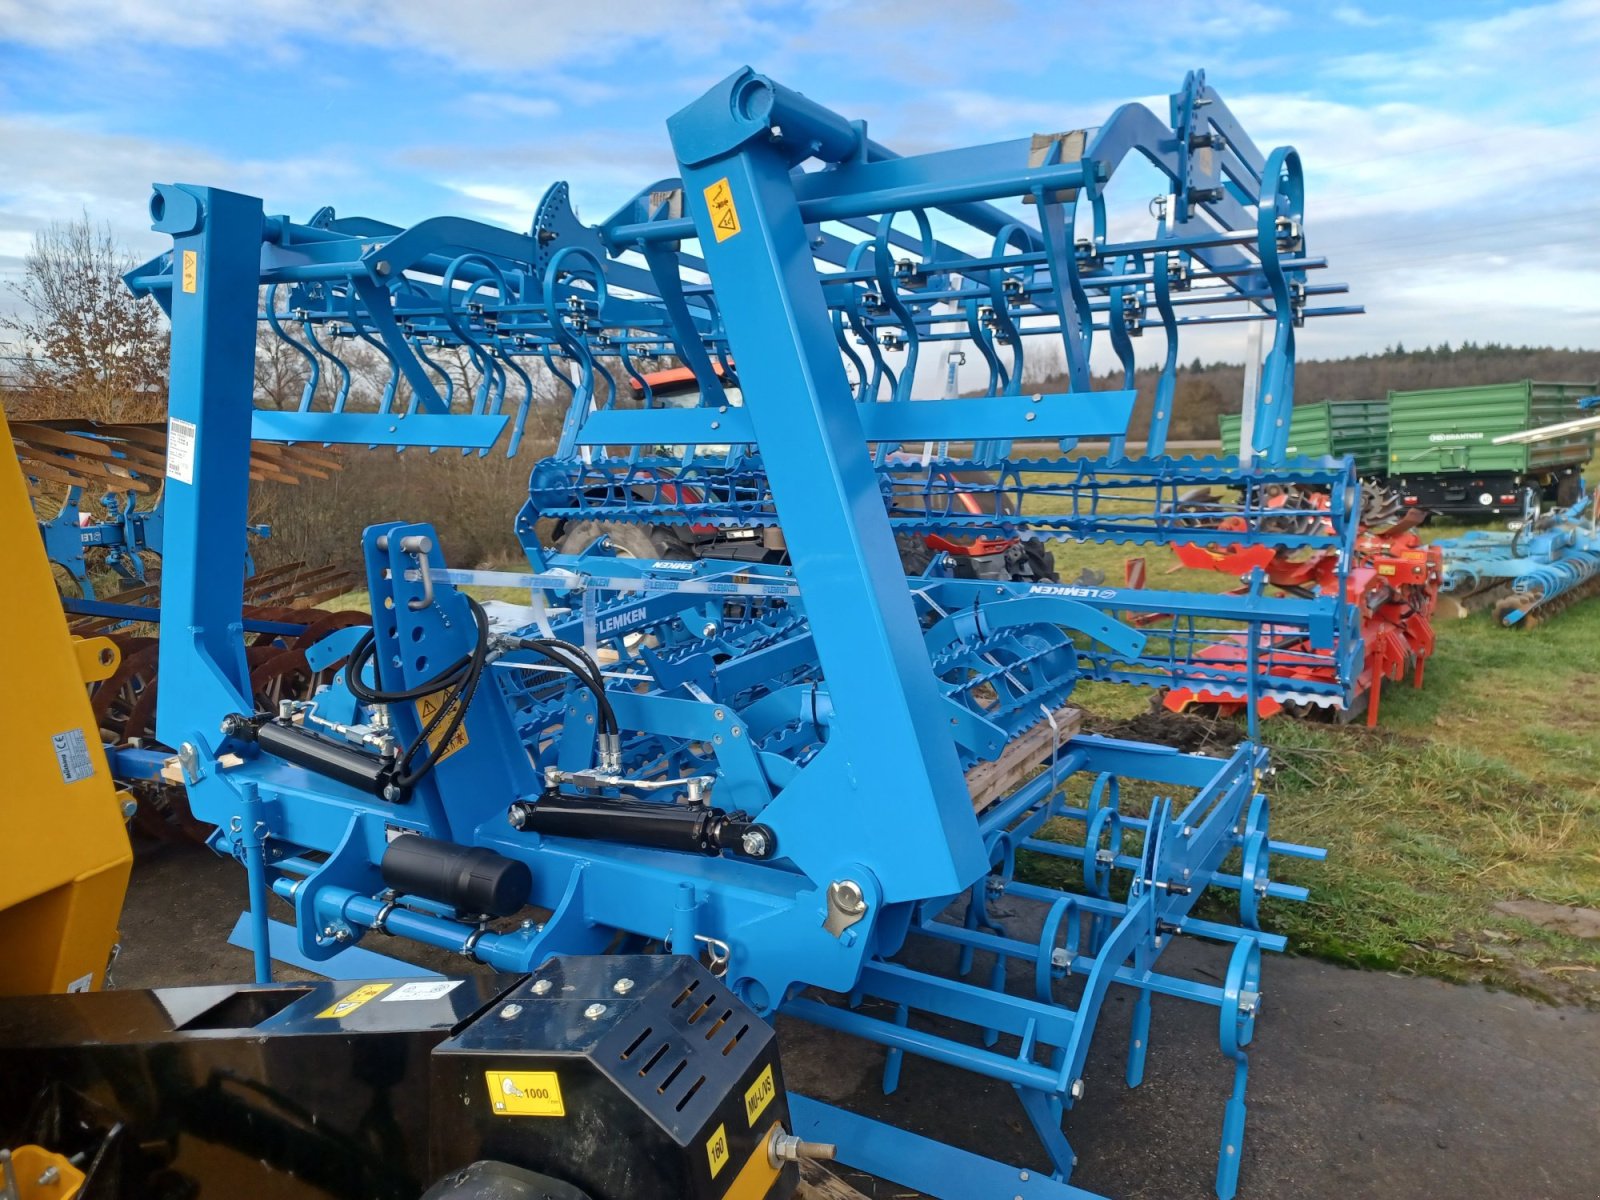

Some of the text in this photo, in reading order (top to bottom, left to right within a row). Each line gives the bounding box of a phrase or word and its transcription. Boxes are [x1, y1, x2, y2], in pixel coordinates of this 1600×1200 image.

[1029, 585, 1100, 598] LEMKEN
[599, 606, 647, 634] LEMKEN
[524, 1088, 549, 1099] 1000
[711, 1136, 724, 1163] 160
